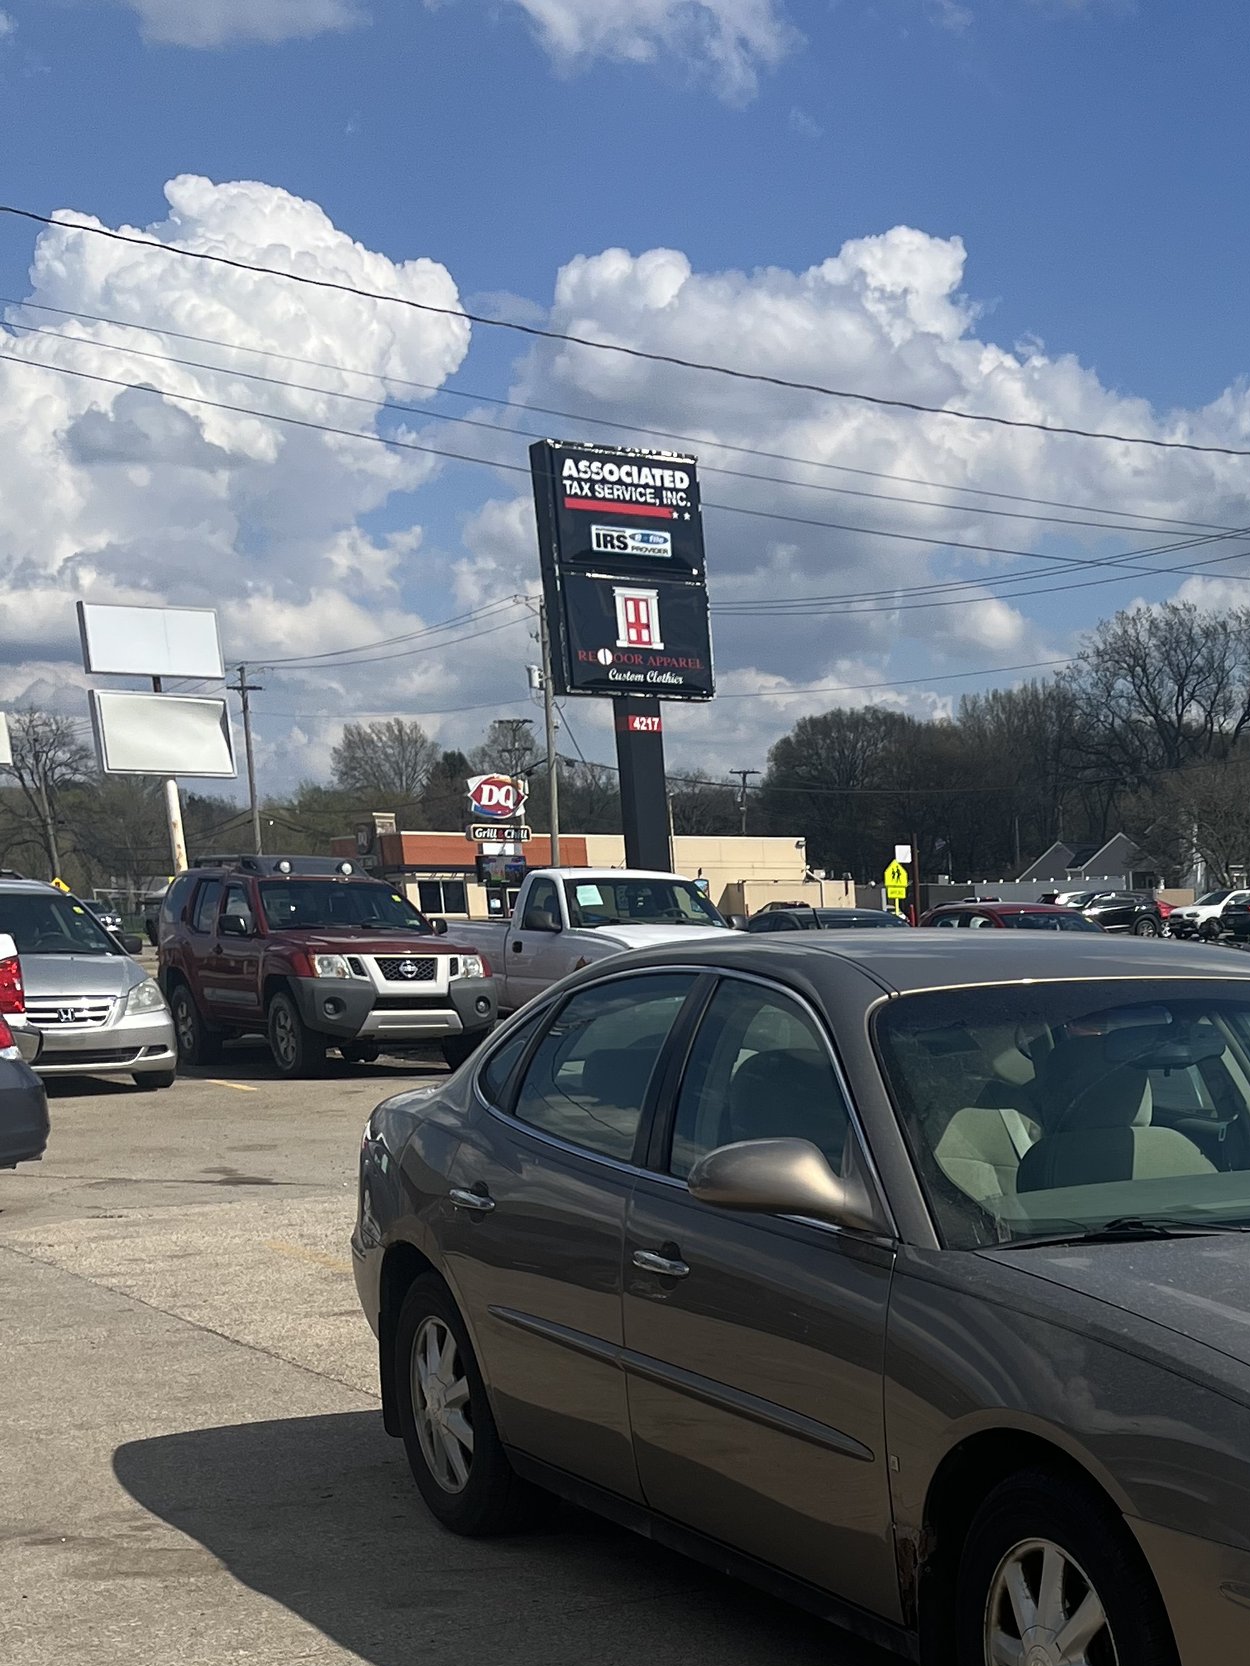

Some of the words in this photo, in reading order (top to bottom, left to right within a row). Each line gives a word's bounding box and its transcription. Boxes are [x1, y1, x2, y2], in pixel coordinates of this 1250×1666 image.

[562, 458, 690, 489] ASSOCIATED
[562, 480, 592, 497] TAX
[594, 483, 660, 506] SERVICE,
[662, 490, 691, 507] INC.
[595, 532, 628, 551] IRS
[647, 655, 704, 669] APPAREL
[608, 668, 644, 683] Custom
[646, 669, 684, 685] Clothier
[633, 716, 660, 731] 4217
[480, 784, 517, 809] DQ
[475, 828, 497, 839] Grill
